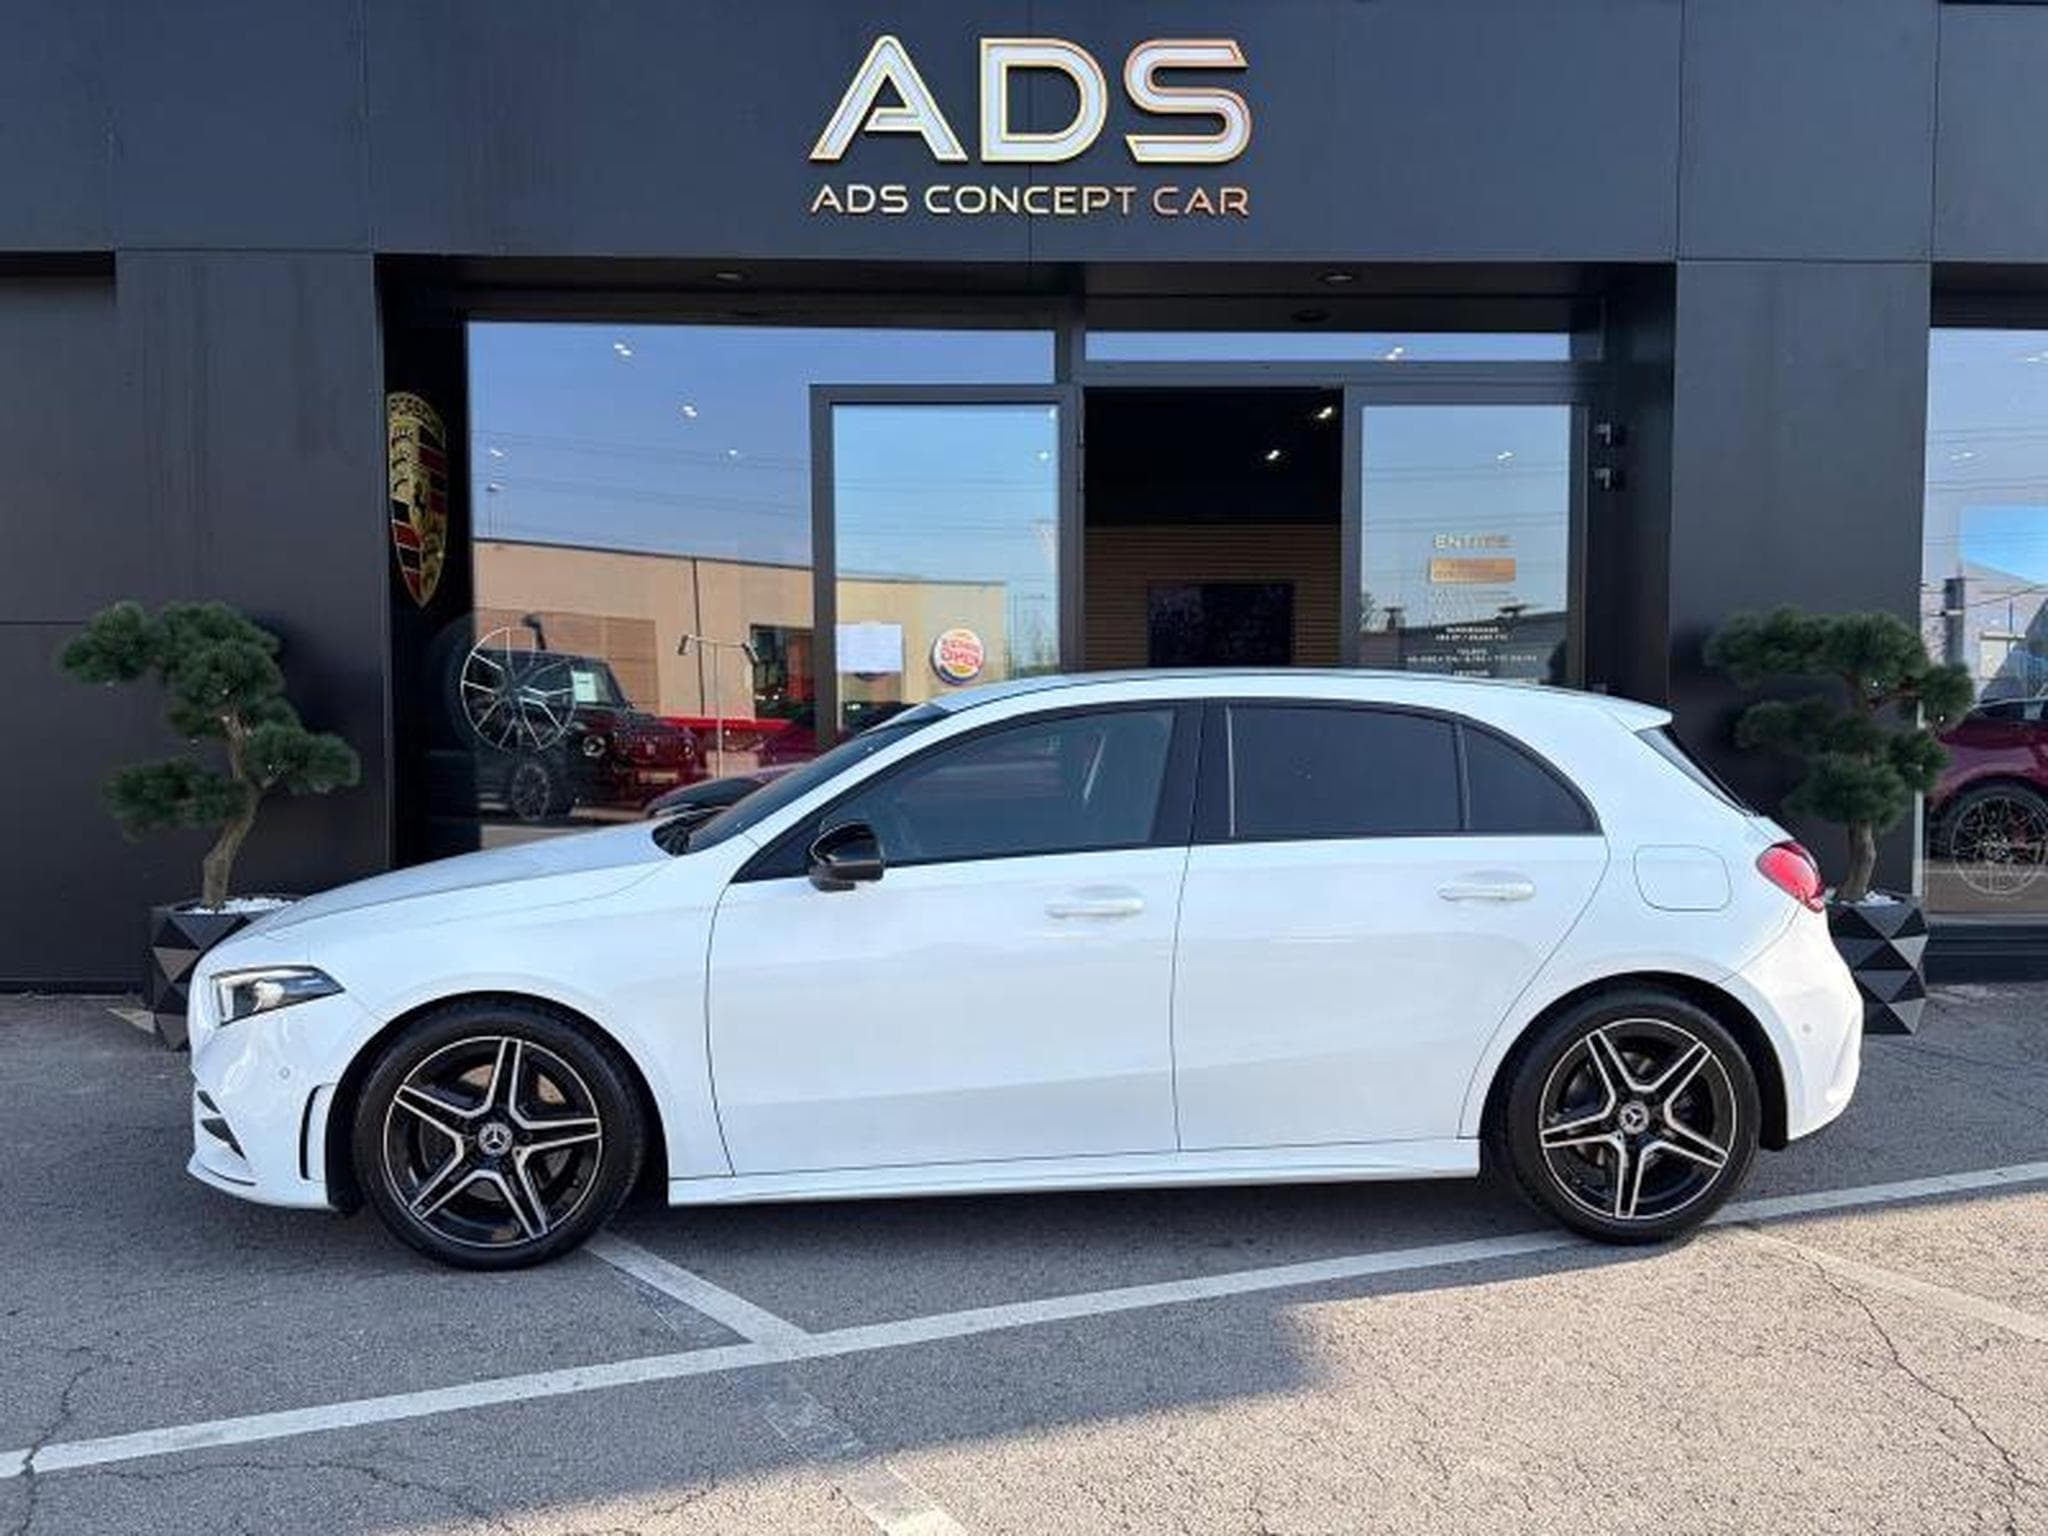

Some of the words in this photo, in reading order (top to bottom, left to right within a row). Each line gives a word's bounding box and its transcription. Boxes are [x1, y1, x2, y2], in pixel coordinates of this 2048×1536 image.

[809, 34, 1252, 163] ADS
[811, 184, 908, 215] ADS
[925, 184, 1136, 215] CONCEPT
[1152, 186, 1250, 216] CAR
